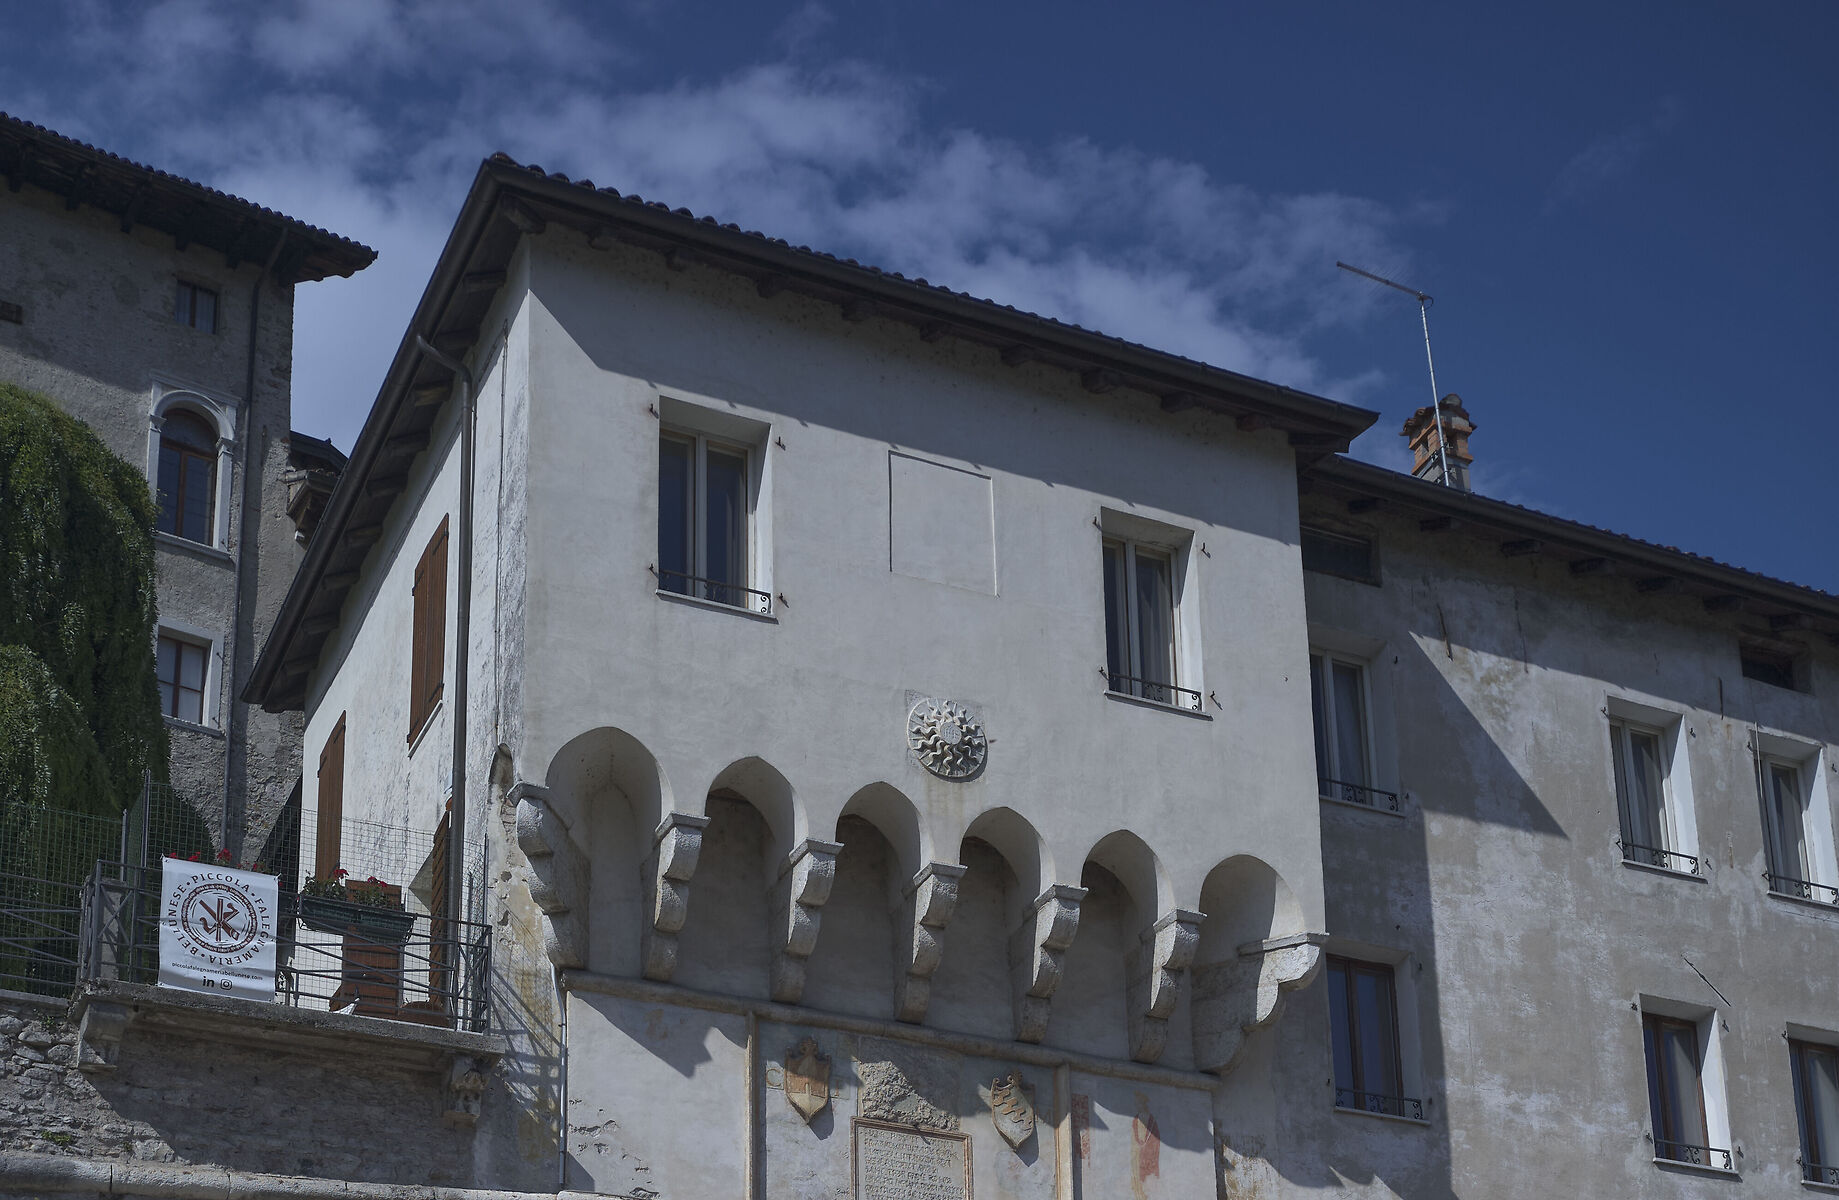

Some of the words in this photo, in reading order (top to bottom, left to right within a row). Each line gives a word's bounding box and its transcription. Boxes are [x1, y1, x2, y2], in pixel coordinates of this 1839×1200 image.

[191, 872, 250, 892] PICCOLA
[168, 884, 199, 956] BELLUNESE
[208, 897, 271, 966] FALEGNAMERIA
[171, 962, 264, 981] piccolafalegnameriabellunese.com
